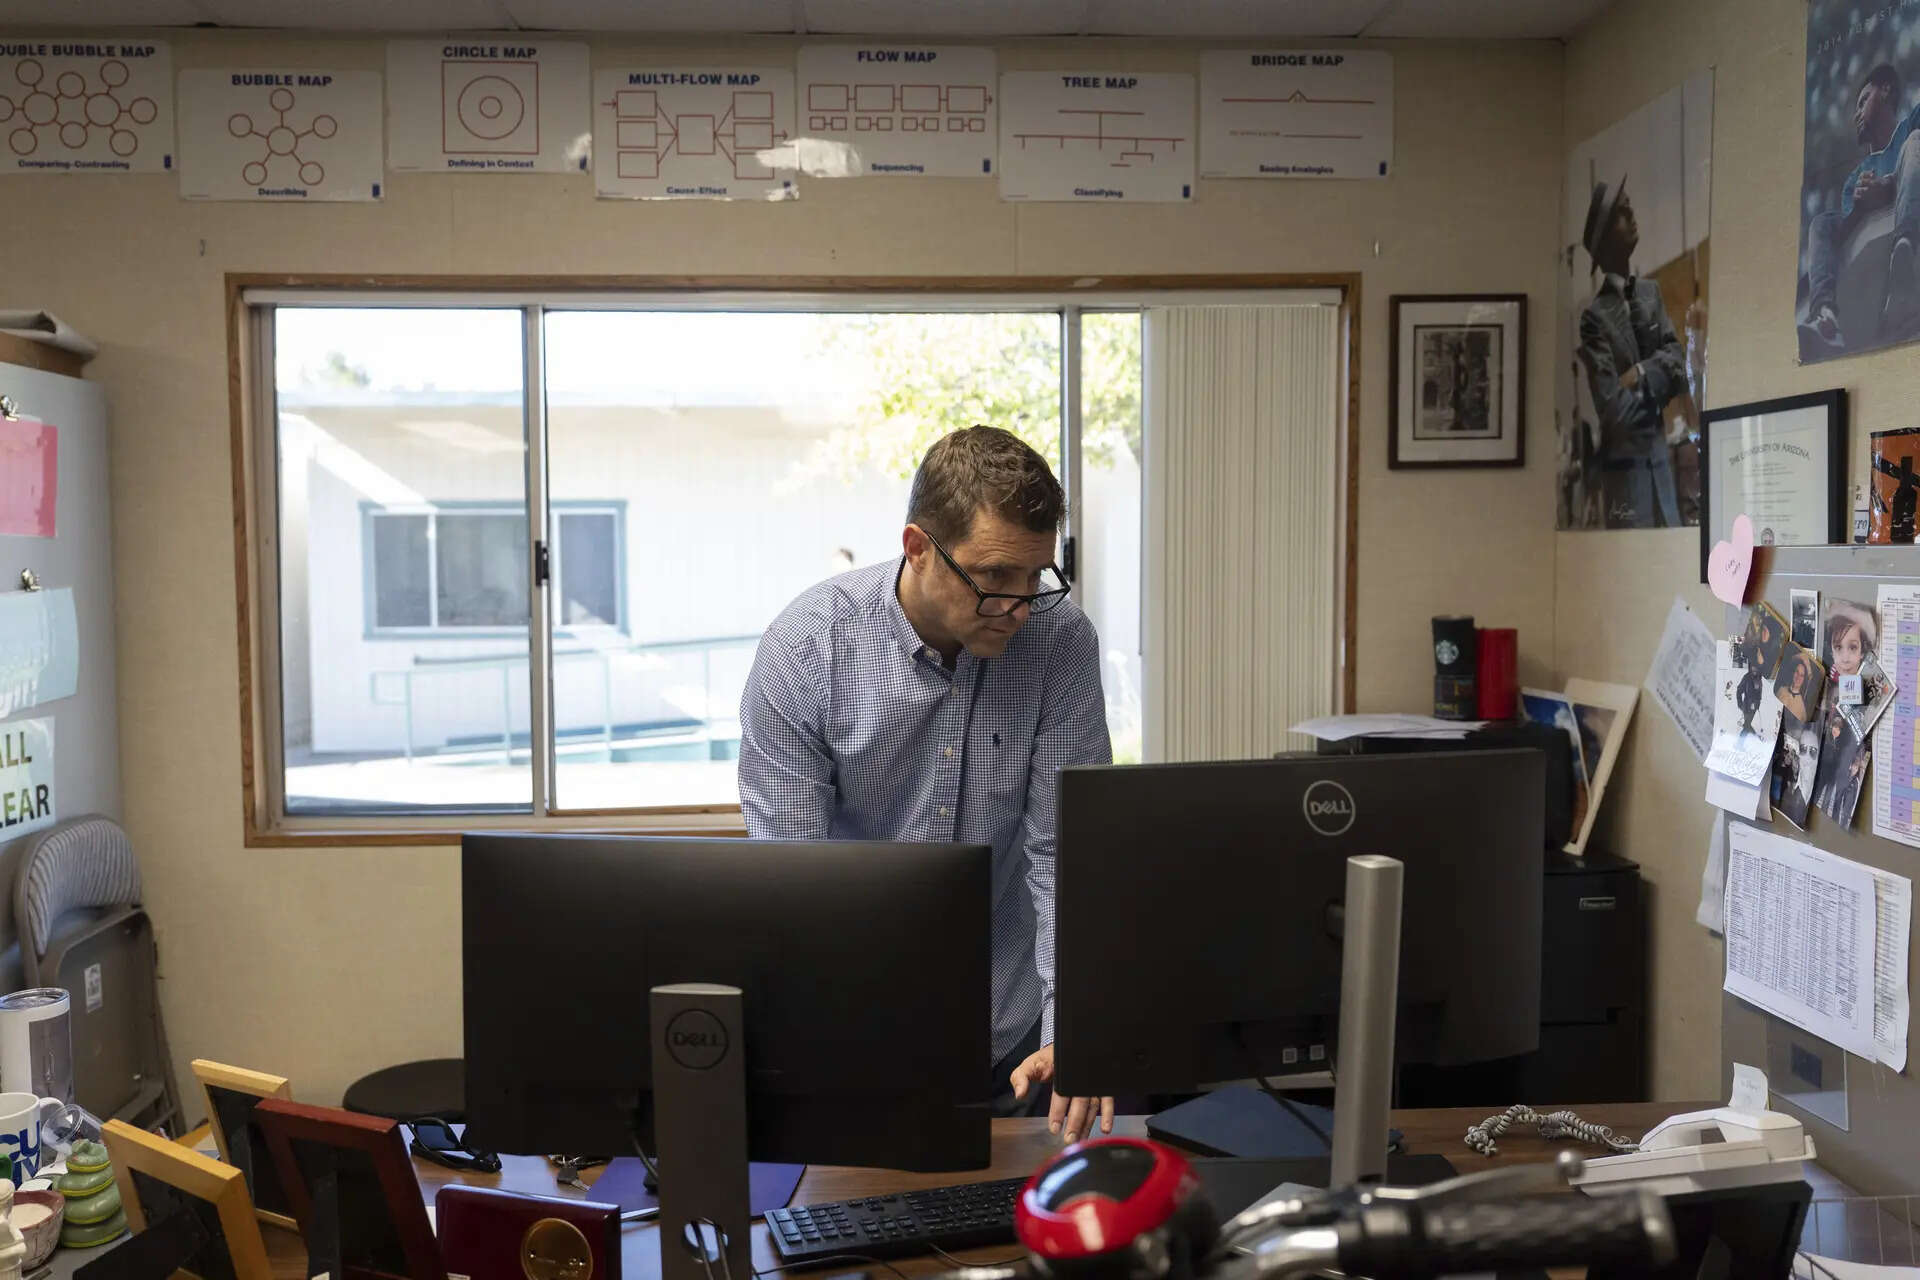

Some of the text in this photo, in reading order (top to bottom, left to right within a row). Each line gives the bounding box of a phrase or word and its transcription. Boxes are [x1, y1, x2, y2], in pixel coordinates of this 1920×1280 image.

[52, 44, 116, 57] BUBBLE
[121, 45, 156, 58] MAP
[442, 46, 537, 58] CIRCLE MAP
[857, 50, 937, 63] FLOW MAP
[1251, 55, 1345, 67] BRIDGE MAP
[231, 74, 333, 87] BUBBLE MAP
[628, 73, 761, 86] MULTI-FLOW MAP
[1062, 76, 1138, 89] TREE MAP
[448, 159, 534, 168] Defining in Context
[871, 163, 924, 173] Sequencing
[258, 187, 307, 197] Describing
[1073, 188, 1123, 198] Classifying
[1781, 442, 1811, 461] ARIZONA
[0, 784, 51, 828] EAR
[1310, 799, 1351, 815] DELL
[672, 1031, 728, 1047] DELL
